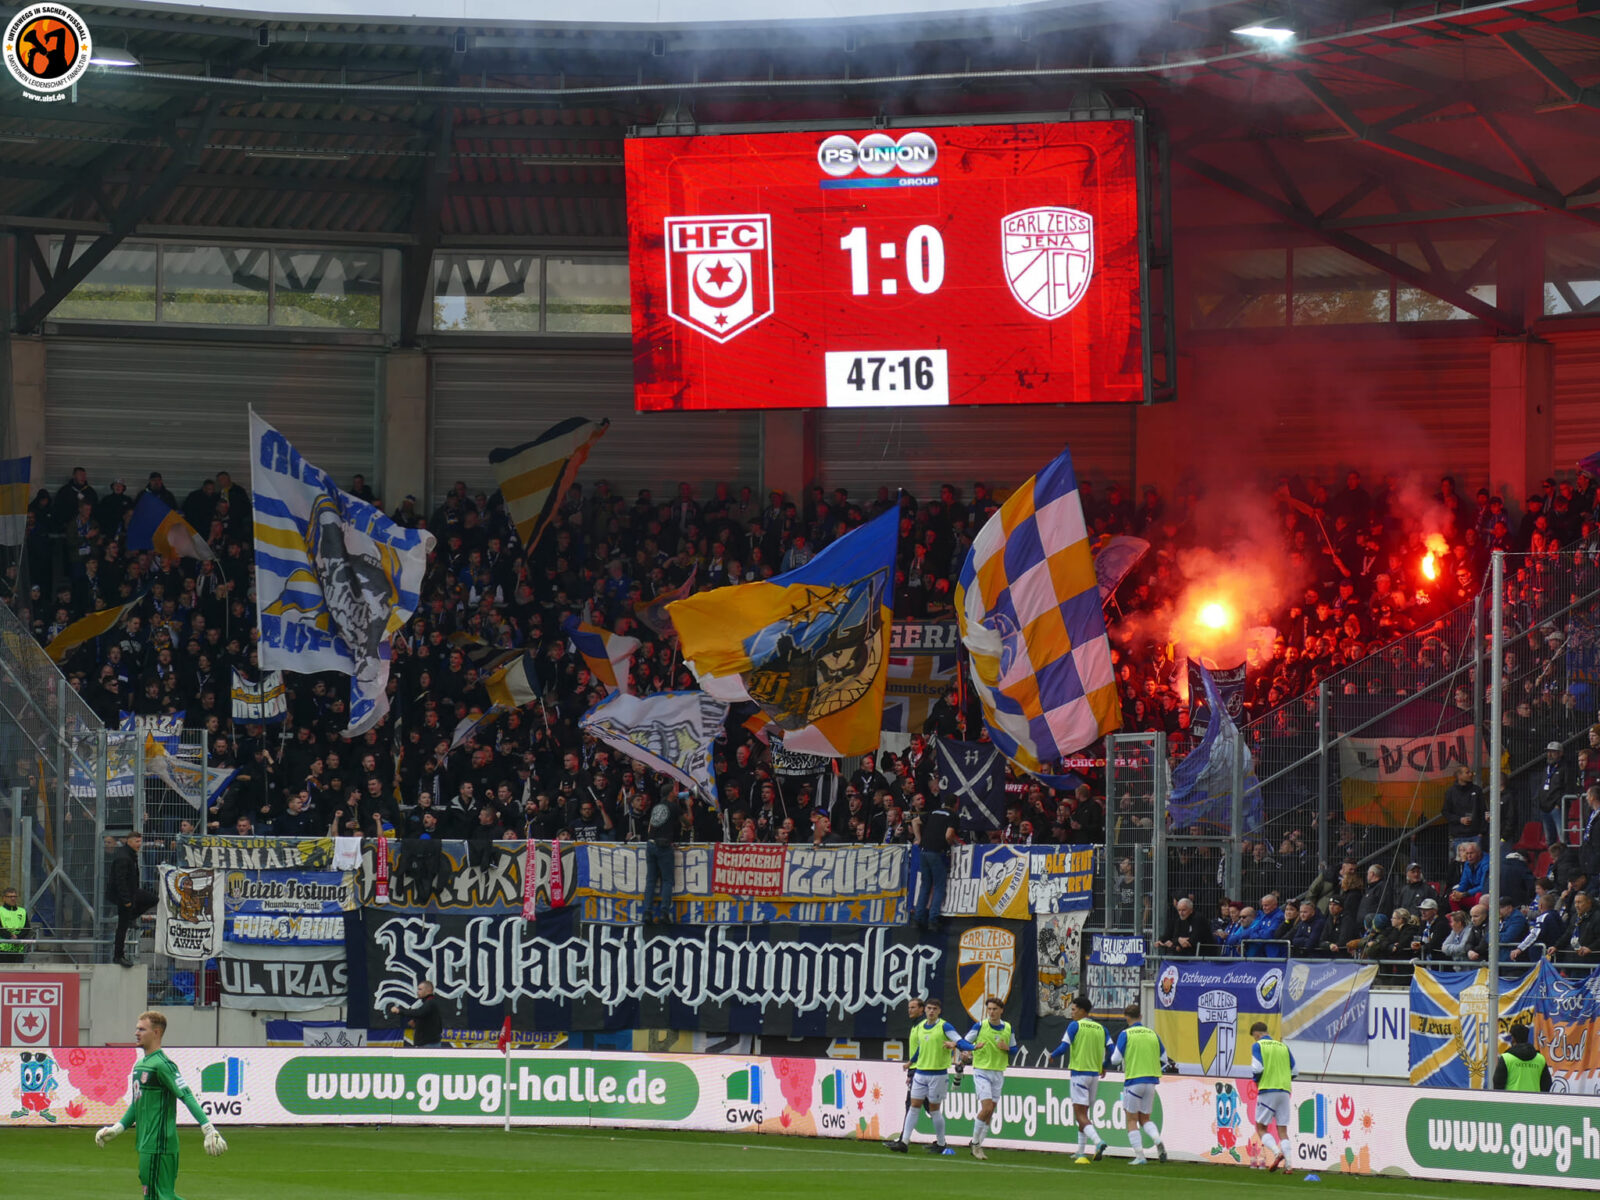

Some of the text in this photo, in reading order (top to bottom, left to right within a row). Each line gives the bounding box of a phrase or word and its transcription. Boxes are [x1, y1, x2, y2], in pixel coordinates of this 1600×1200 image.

[825, 145, 930, 164] PS UNION
[899, 176, 938, 187] GROUP
[1008, 216, 1087, 234] CARL ZEISS
[679, 224, 758, 250] HFC
[1021, 233, 1073, 249] JENA
[839, 224, 945, 297] 1:0
[847, 355, 934, 392] 47:16
[201, 836, 277, 849] SEKTION
[184, 844, 304, 870] WEIMAR
[716, 850, 782, 869] SCHICKERIA
[715, 867, 781, 888] MÜNCHEN
[241, 877, 349, 902] Letzte Festung
[173, 937, 203, 951] AWAY
[963, 931, 1013, 947] CARL ZEISS
[969, 950, 1003, 961] JENA
[220, 958, 348, 997] ULTRAS
[1087, 964, 1141, 987] REFUGEES
[1181, 971, 1257, 986] Ostbayern Chaoten
[7, 988, 56, 1004] HFC
[1087, 986, 1140, 1010] WELCOME
[1200, 994, 1235, 1008] CARL ZEISS
[1205, 1010, 1229, 1022] JENA
[1325, 1000, 1366, 1040] TRIPTIS
[1418, 1016, 1453, 1035] Jena
[307, 1066, 667, 1112] www.gwg-halle.de
[726, 1108, 763, 1124] GWG
[822, 1113, 846, 1129] GWG
[1298, 1143, 1327, 1161] GWG
